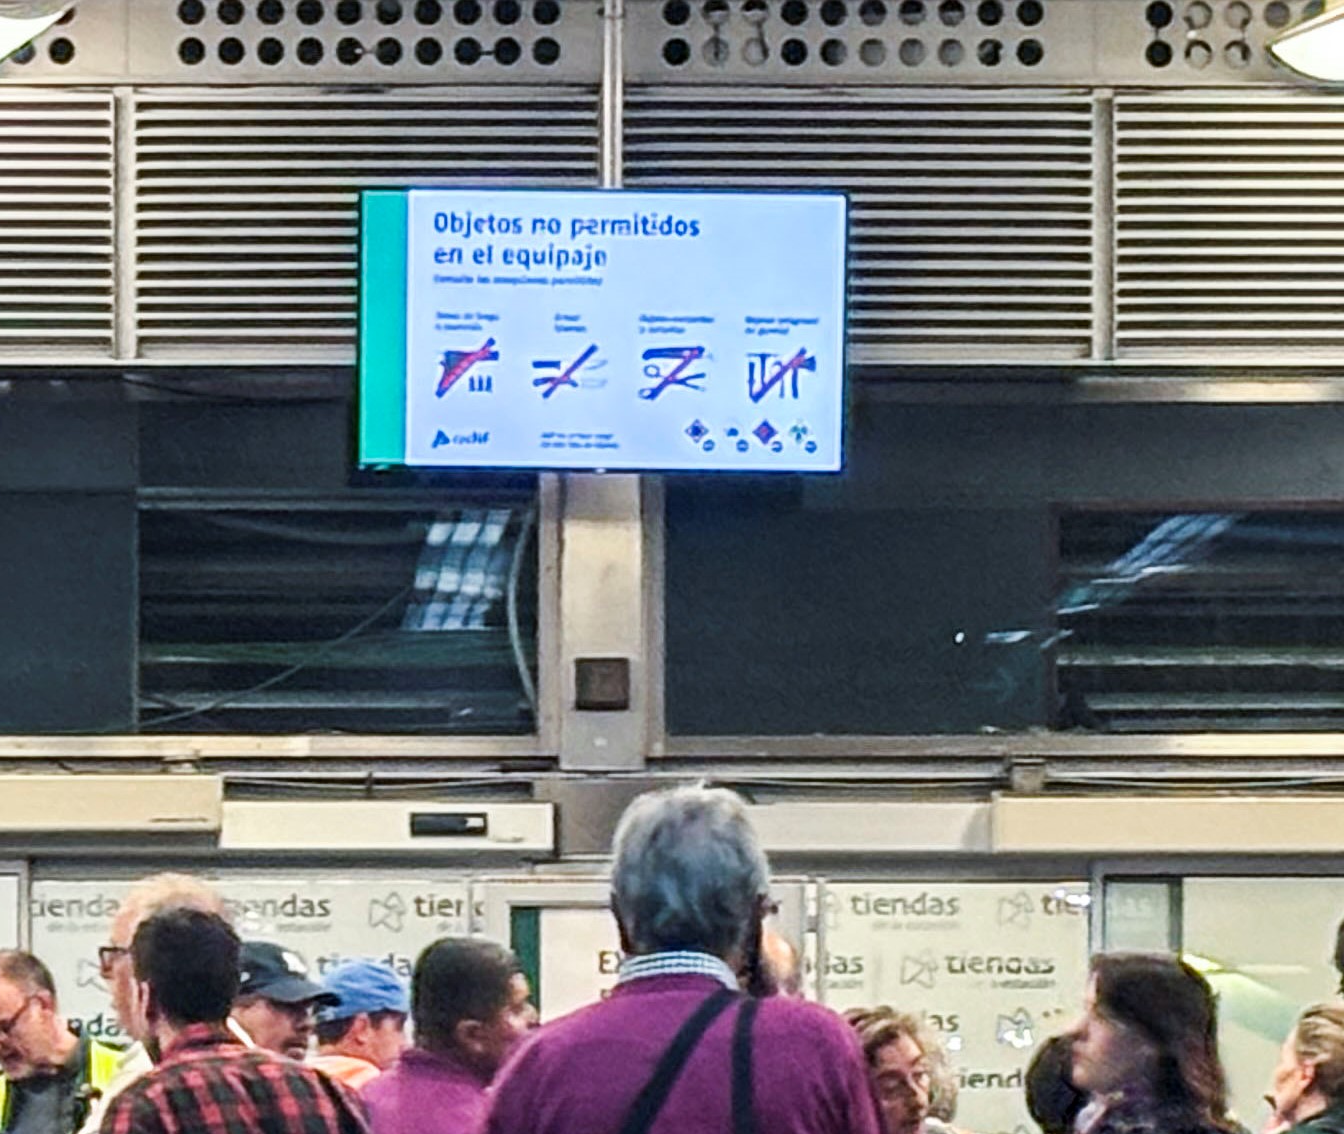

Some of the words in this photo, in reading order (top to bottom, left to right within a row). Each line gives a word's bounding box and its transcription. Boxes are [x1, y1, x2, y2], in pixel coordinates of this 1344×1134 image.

[434, 211, 523, 239] Objetos
[532, 217, 561, 236] no
[570, 212, 700, 240] permitidos
[434, 247, 463, 265] en
[472, 245, 493, 265] el
[503, 243, 607, 271] equipaje
[851, 892, 960, 916] tiendas
[945, 953, 1055, 974] tiendas
